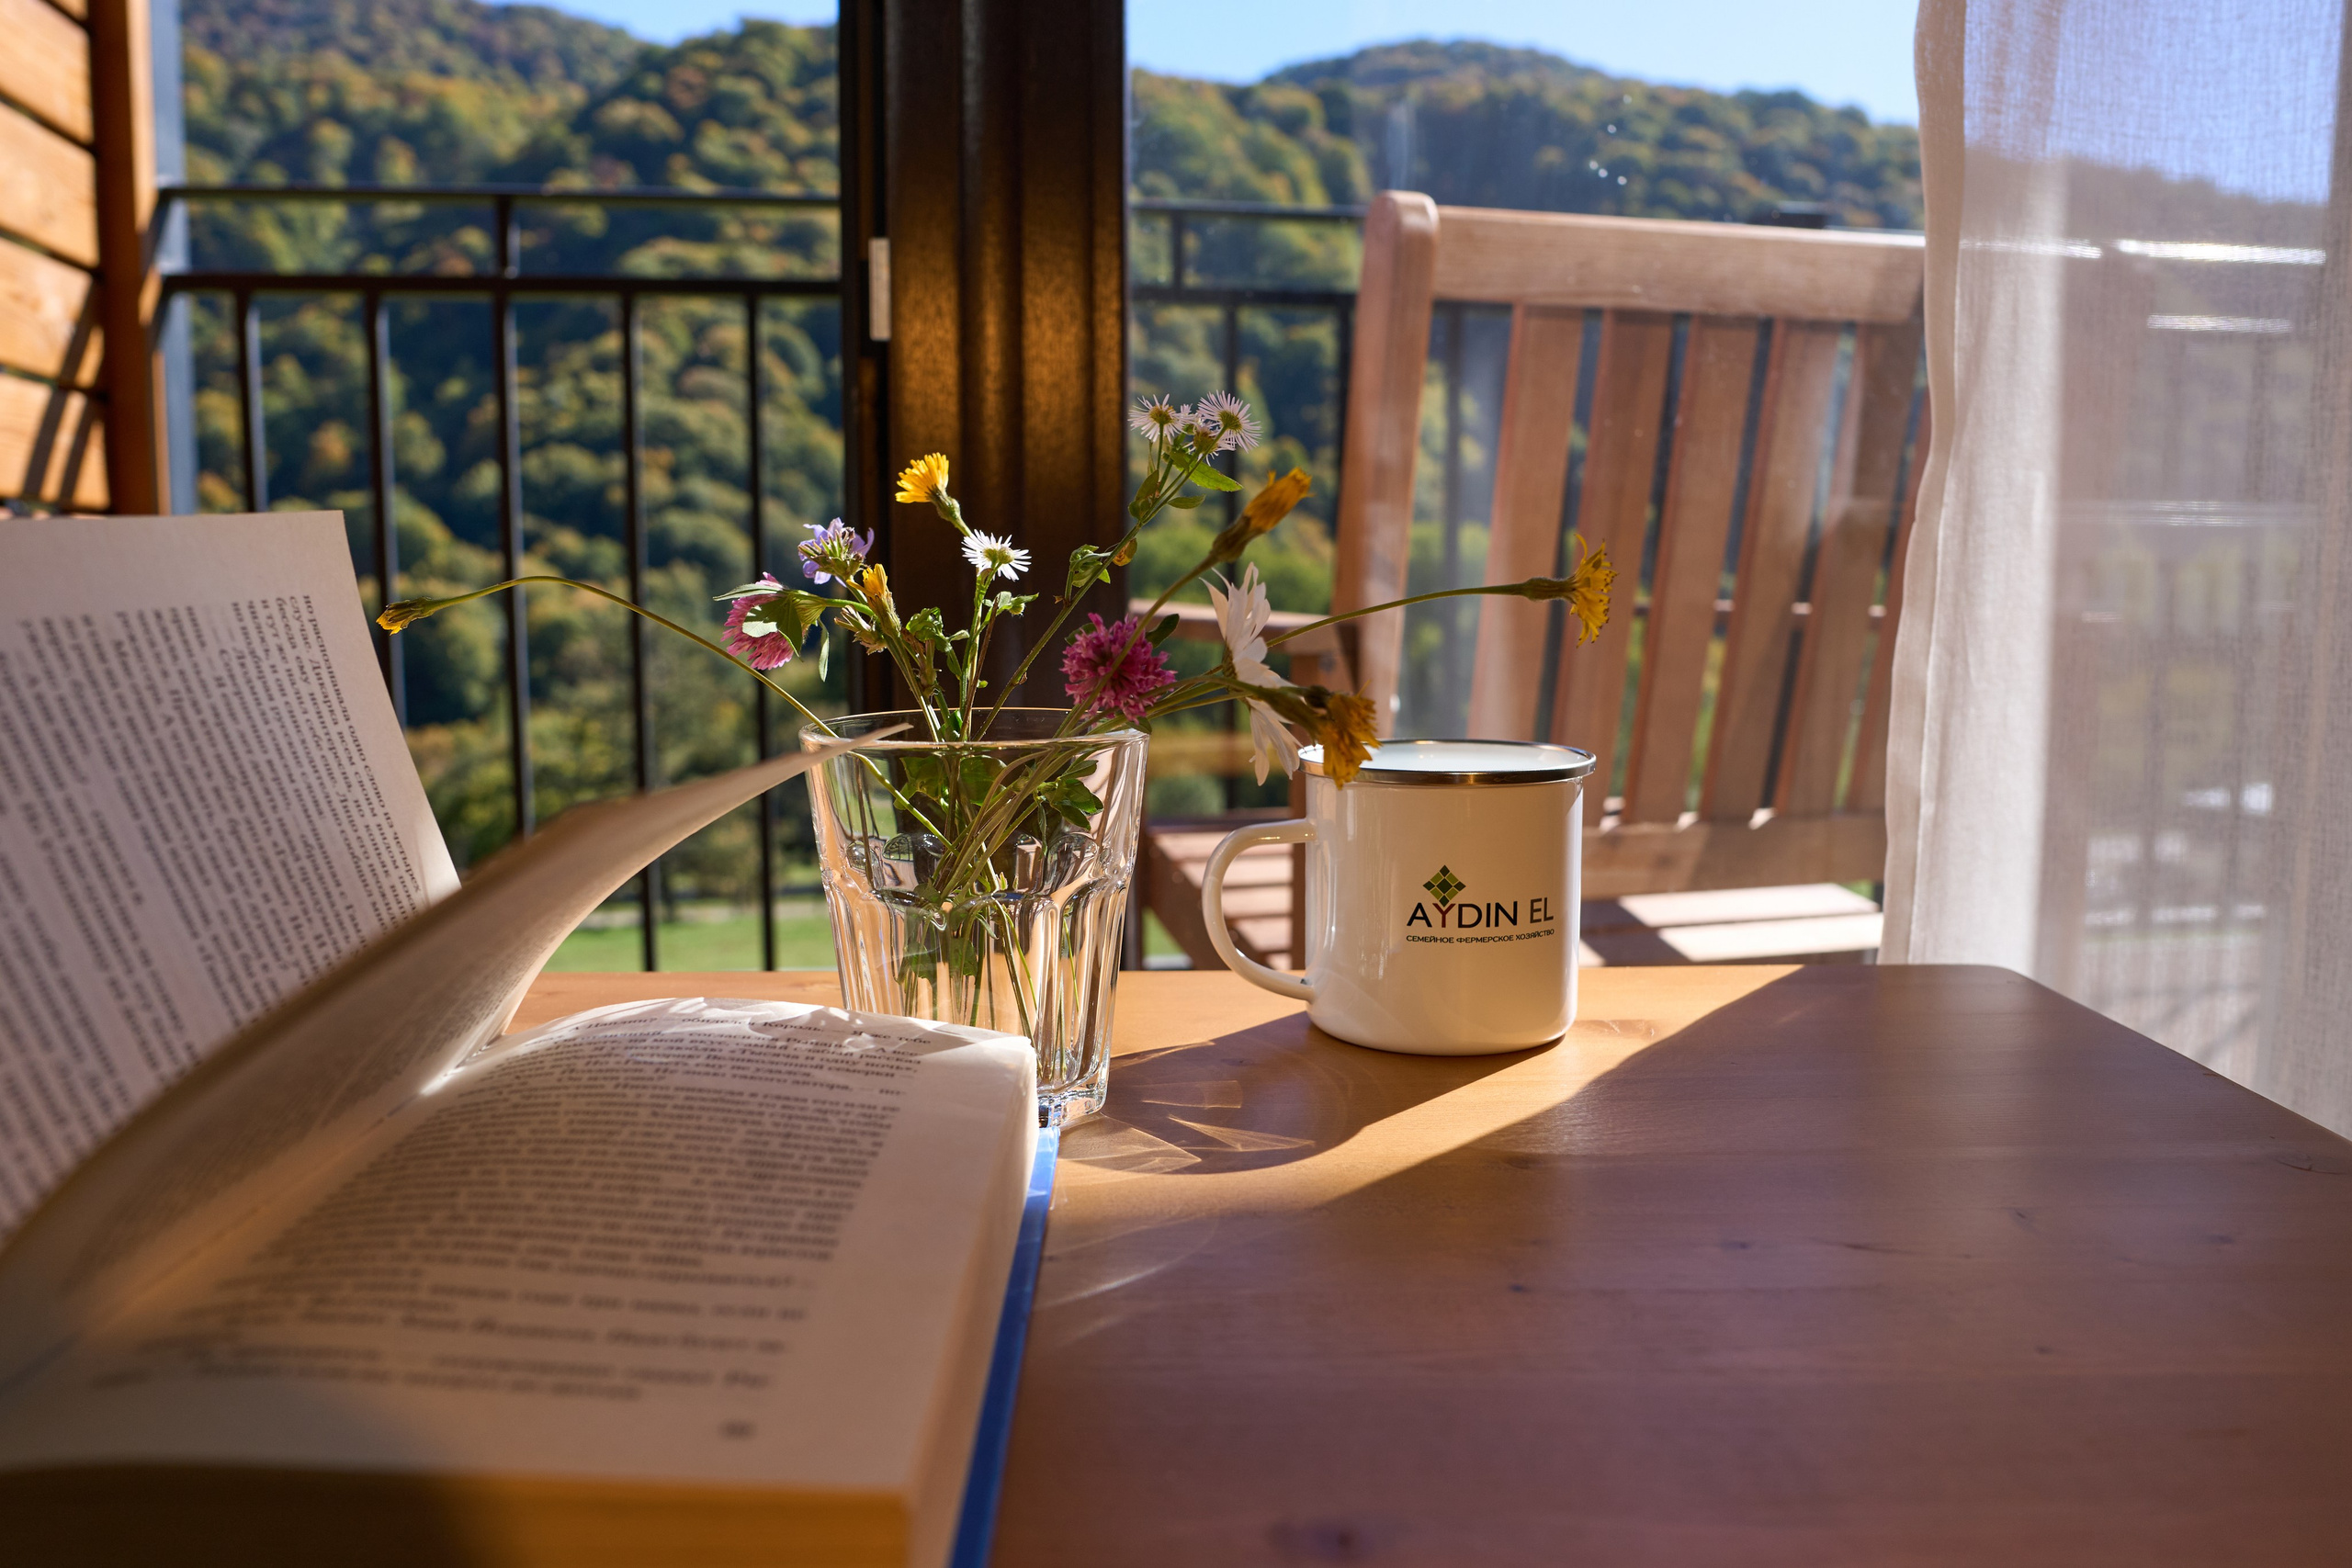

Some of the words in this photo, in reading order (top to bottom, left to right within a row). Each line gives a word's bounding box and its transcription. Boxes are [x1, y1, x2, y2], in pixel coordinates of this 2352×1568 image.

[229, 601, 246, 622] но
[258, 599, 270, 609] и
[300, 595, 314, 615] но
[243, 600, 276, 661] чилось,
[261, 614, 280, 638] тут
[236, 625, 280, 702] подбирая
[268, 663, 280, 675] и
[274, 642, 289, 663] же
[306, 617, 351, 721] распознавала
[273, 677, 289, 697] он
[283, 668, 310, 715] налил
[268, 705, 305, 769] русские
[272, 597, 300, 649] беседа
[290, 655, 311, 684] ему
[304, 692, 356, 792] неинтересна,
[351, 798, 368, 818] но
[362, 823, 392, 877] коньяк
[285, 596, 313, 652] случае.
[306, 659, 343, 726] Дикарка
[334, 730, 356, 766] всем
[352, 771, 379, 818] своим
[373, 822, 401, 869] видом
[303, 717, 327, 750] себе
[345, 725, 368, 761] одно
[231, 646, 276, 725] Людмила
[266, 728, 299, 784] совсем
[336, 890, 349, 900] с
[282, 700, 344, 827] снисходительно
[318, 754, 341, 787] еще.
[362, 764, 387, 807] слово
[334, 791, 363, 832] Лицо
[381, 811, 395, 829] из
[335, 829, 378, 897] сообщил
[354, 835, 372, 860] его
[387, 831, 422, 892] четырех
[1407, 900, 1518, 928] AYDIN
[1530, 897, 1554, 923] EL
[1406, 934, 1454, 943] СЕМЕЙНОЕ
[1456, 934, 1514, 943] ФЕРМЕРСКОЕ
[1515, 929, 1555, 941] ХОЗЯЙСТВО
[682, 1017, 755, 1027] обиделся
[762, 1021, 825, 1033] Король.
[898, 1035, 932, 1044] тебе
